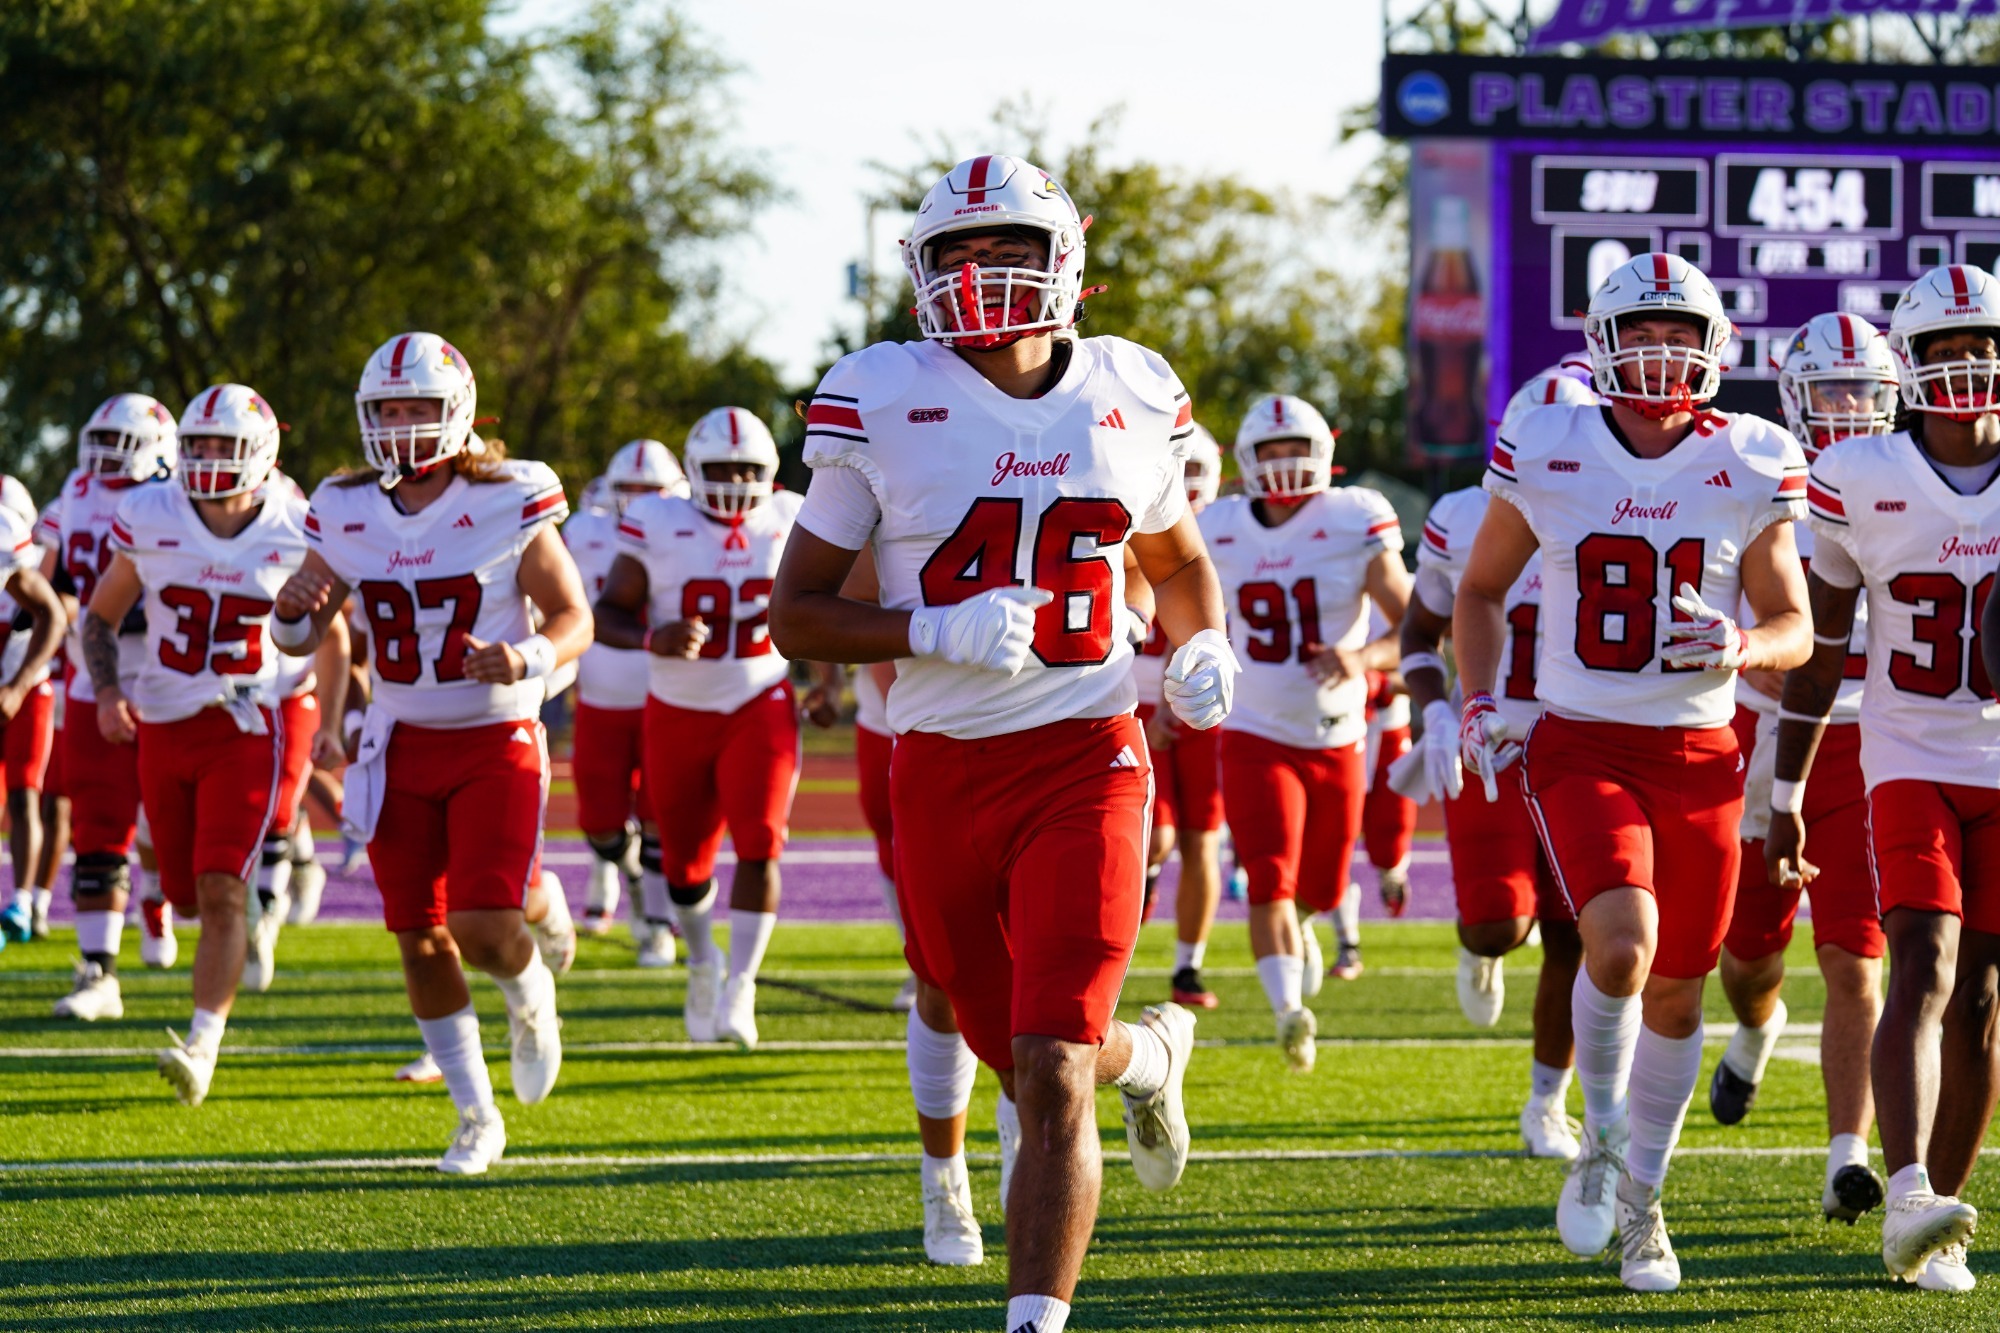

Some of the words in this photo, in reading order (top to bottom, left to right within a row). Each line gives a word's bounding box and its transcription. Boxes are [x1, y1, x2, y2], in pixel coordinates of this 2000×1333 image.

[1469, 72, 1795, 132] PLASTER
[1803, 79, 2000, 135] STAD
[1748, 168, 1868, 232] 4:54
[991, 451, 1072, 487] Jewell
[1611, 498, 1678, 525] Jewell
[1938, 536, 2000, 563] Jewell
[919, 496, 1132, 667] 46
[1575, 532, 1705, 674] 81
[158, 583, 275, 677] 35
[358, 571, 482, 685] 87
[1238, 576, 1323, 664] 91
